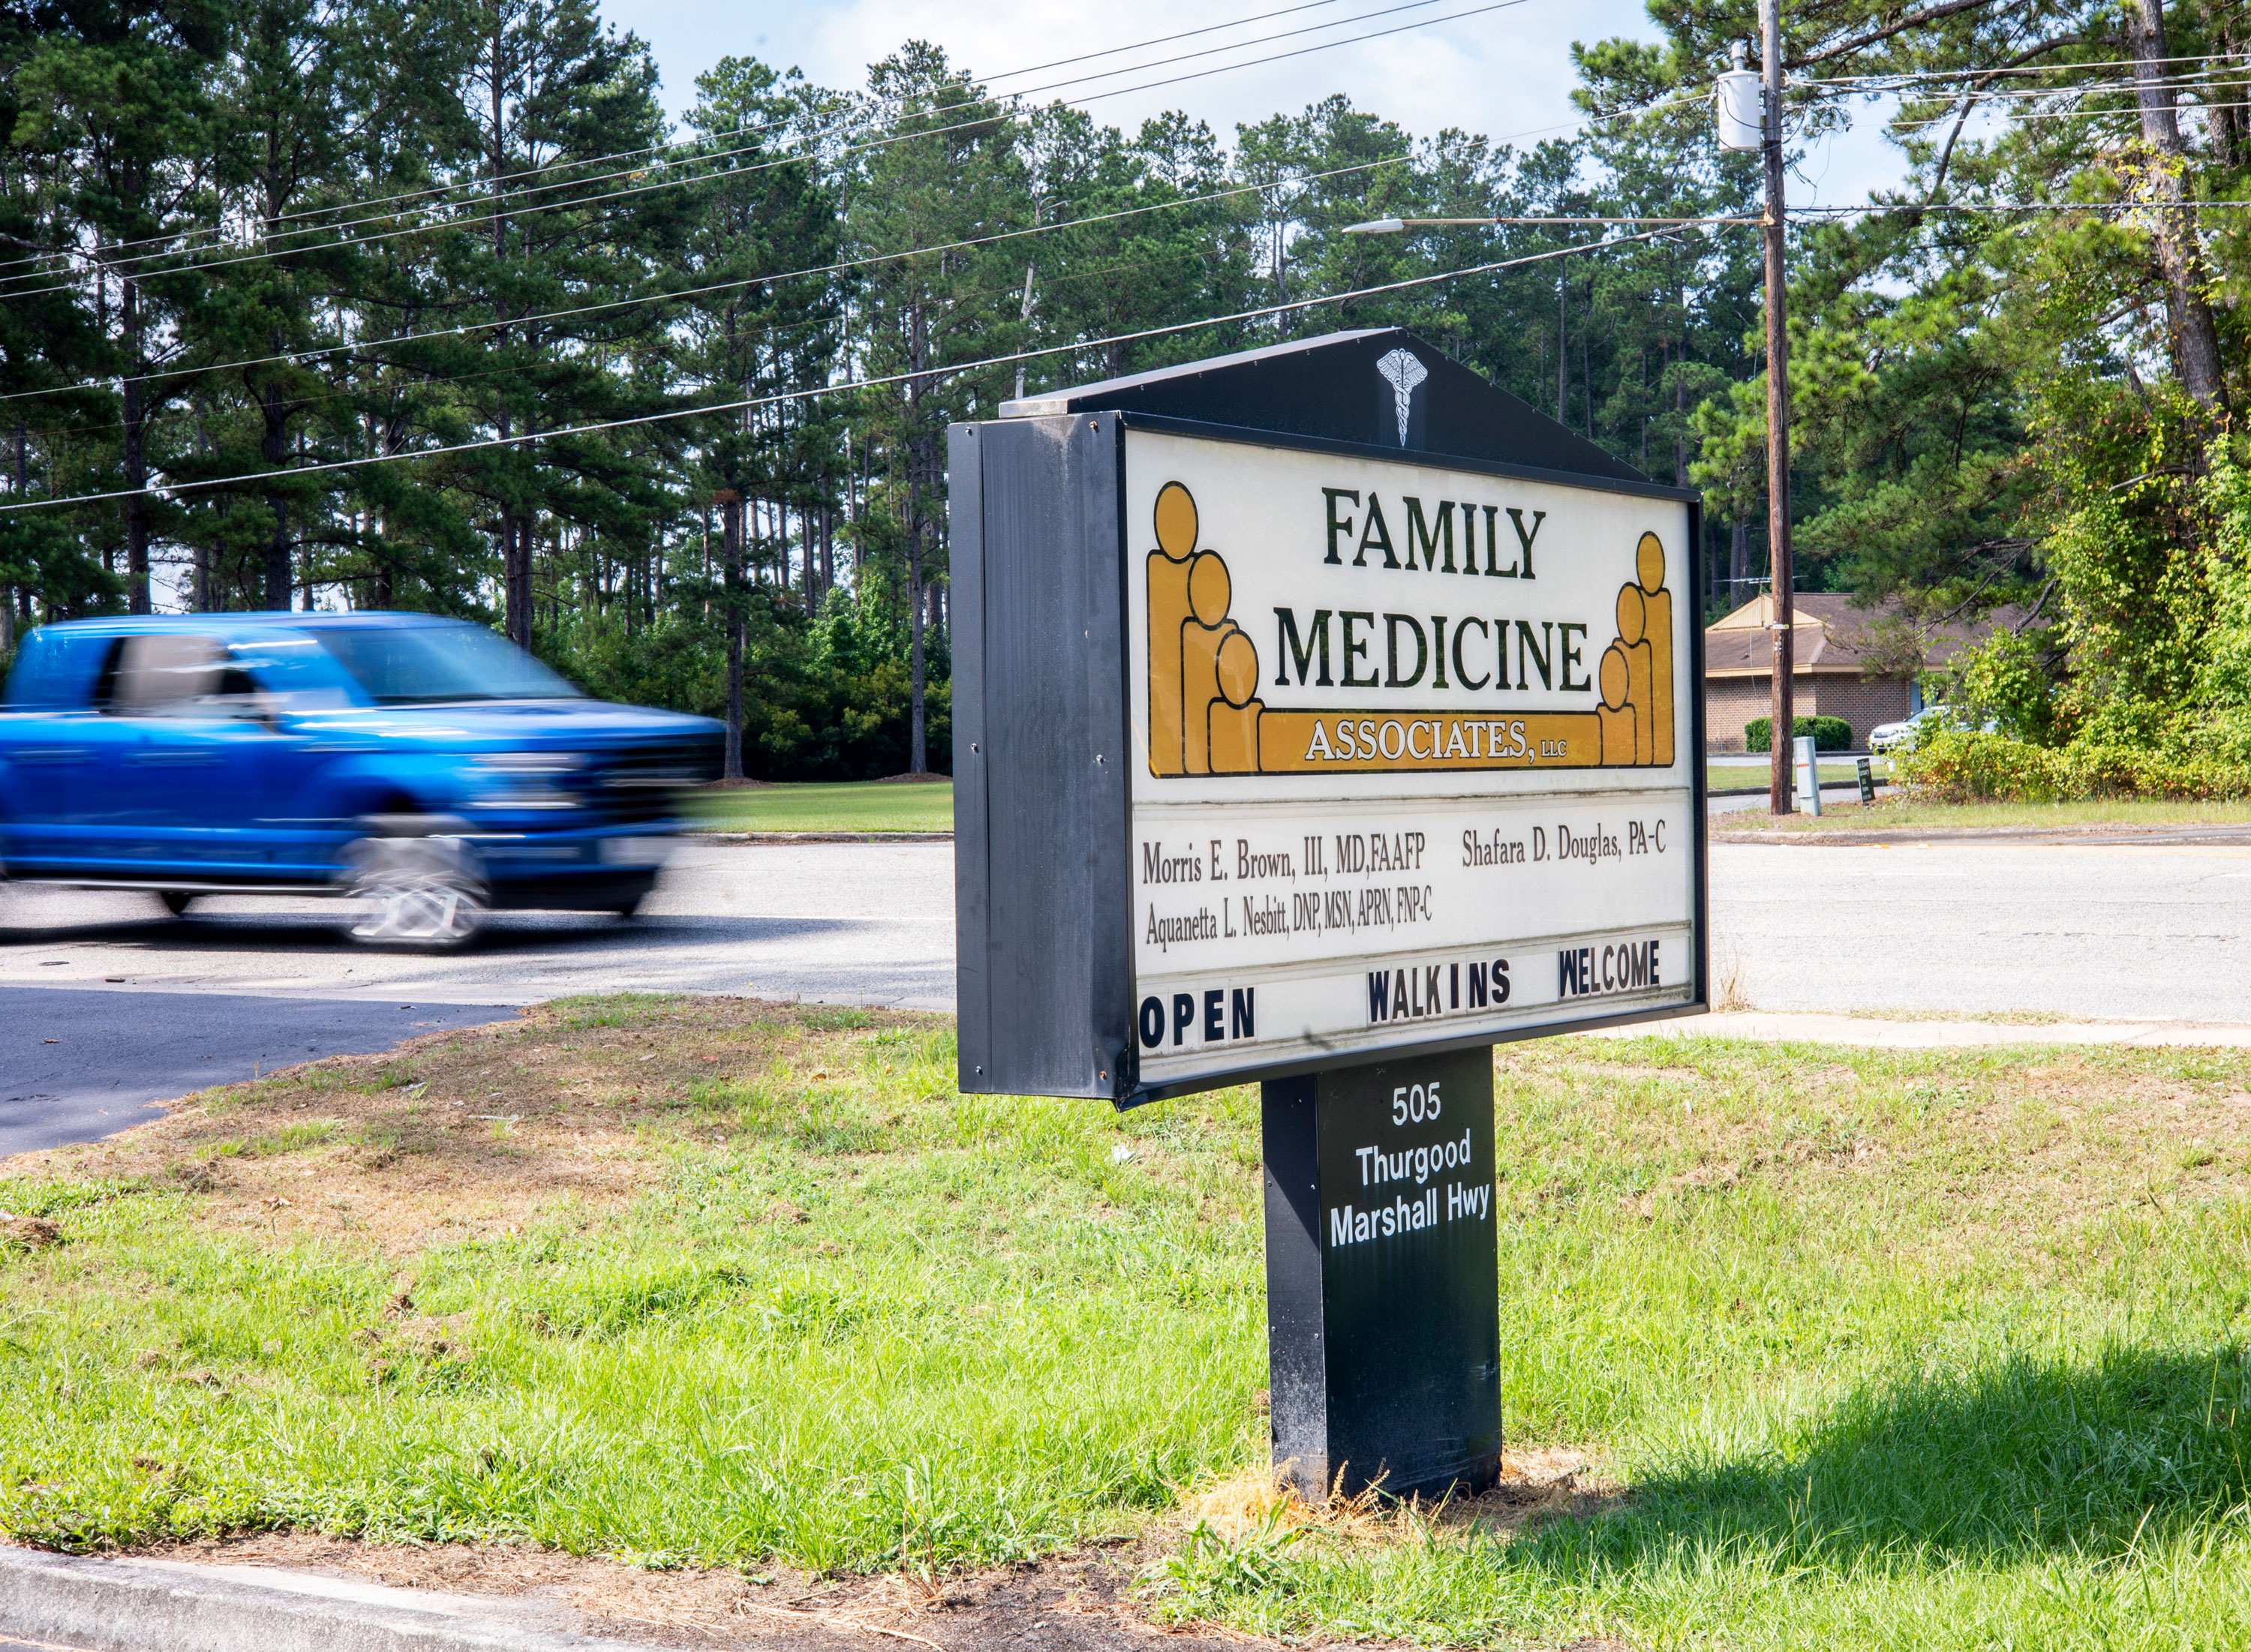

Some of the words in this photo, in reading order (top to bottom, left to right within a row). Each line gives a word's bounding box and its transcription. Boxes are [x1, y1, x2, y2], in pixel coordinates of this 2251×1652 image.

[1321, 486, 1547, 580] FAMILY
[1273, 607, 1592, 692] MEDICINE
[1304, 719, 1535, 764] ASSOCIATES,
[1540, 739, 1567, 758] LLC
[1143, 841, 1201, 885] Morris
[1210, 839, 1228, 882] E.
[1237, 838, 1297, 885] Brown,
[1304, 835, 1328, 883] III,
[1462, 828, 1526, 867] Shafara
[1533, 826, 1550, 862] D.
[1558, 823, 1622, 865] Douglas,
[1629, 819, 1666, 855] PA-C
[1146, 901, 1218, 953] Aquanetta
[1224, 897, 1237, 938] L.
[1243, 894, 1290, 941] Nesbitt,
[1294, 892, 1321, 938] DNP,
[1324, 890, 1354, 935] MSN,
[1357, 888, 1394, 932] APRN,
[1397, 885, 1432, 924] FNP-C
[1139, 987, 1255, 1049] OPEN
[1559, 939, 1660, 998] WELCOME
[1392, 1081, 1441, 1125] 505
[1356, 1128, 1471, 1186] Thurgood
[1330, 1188, 1438, 1248] Marshall
[1447, 1181, 1490, 1221] Hwy
